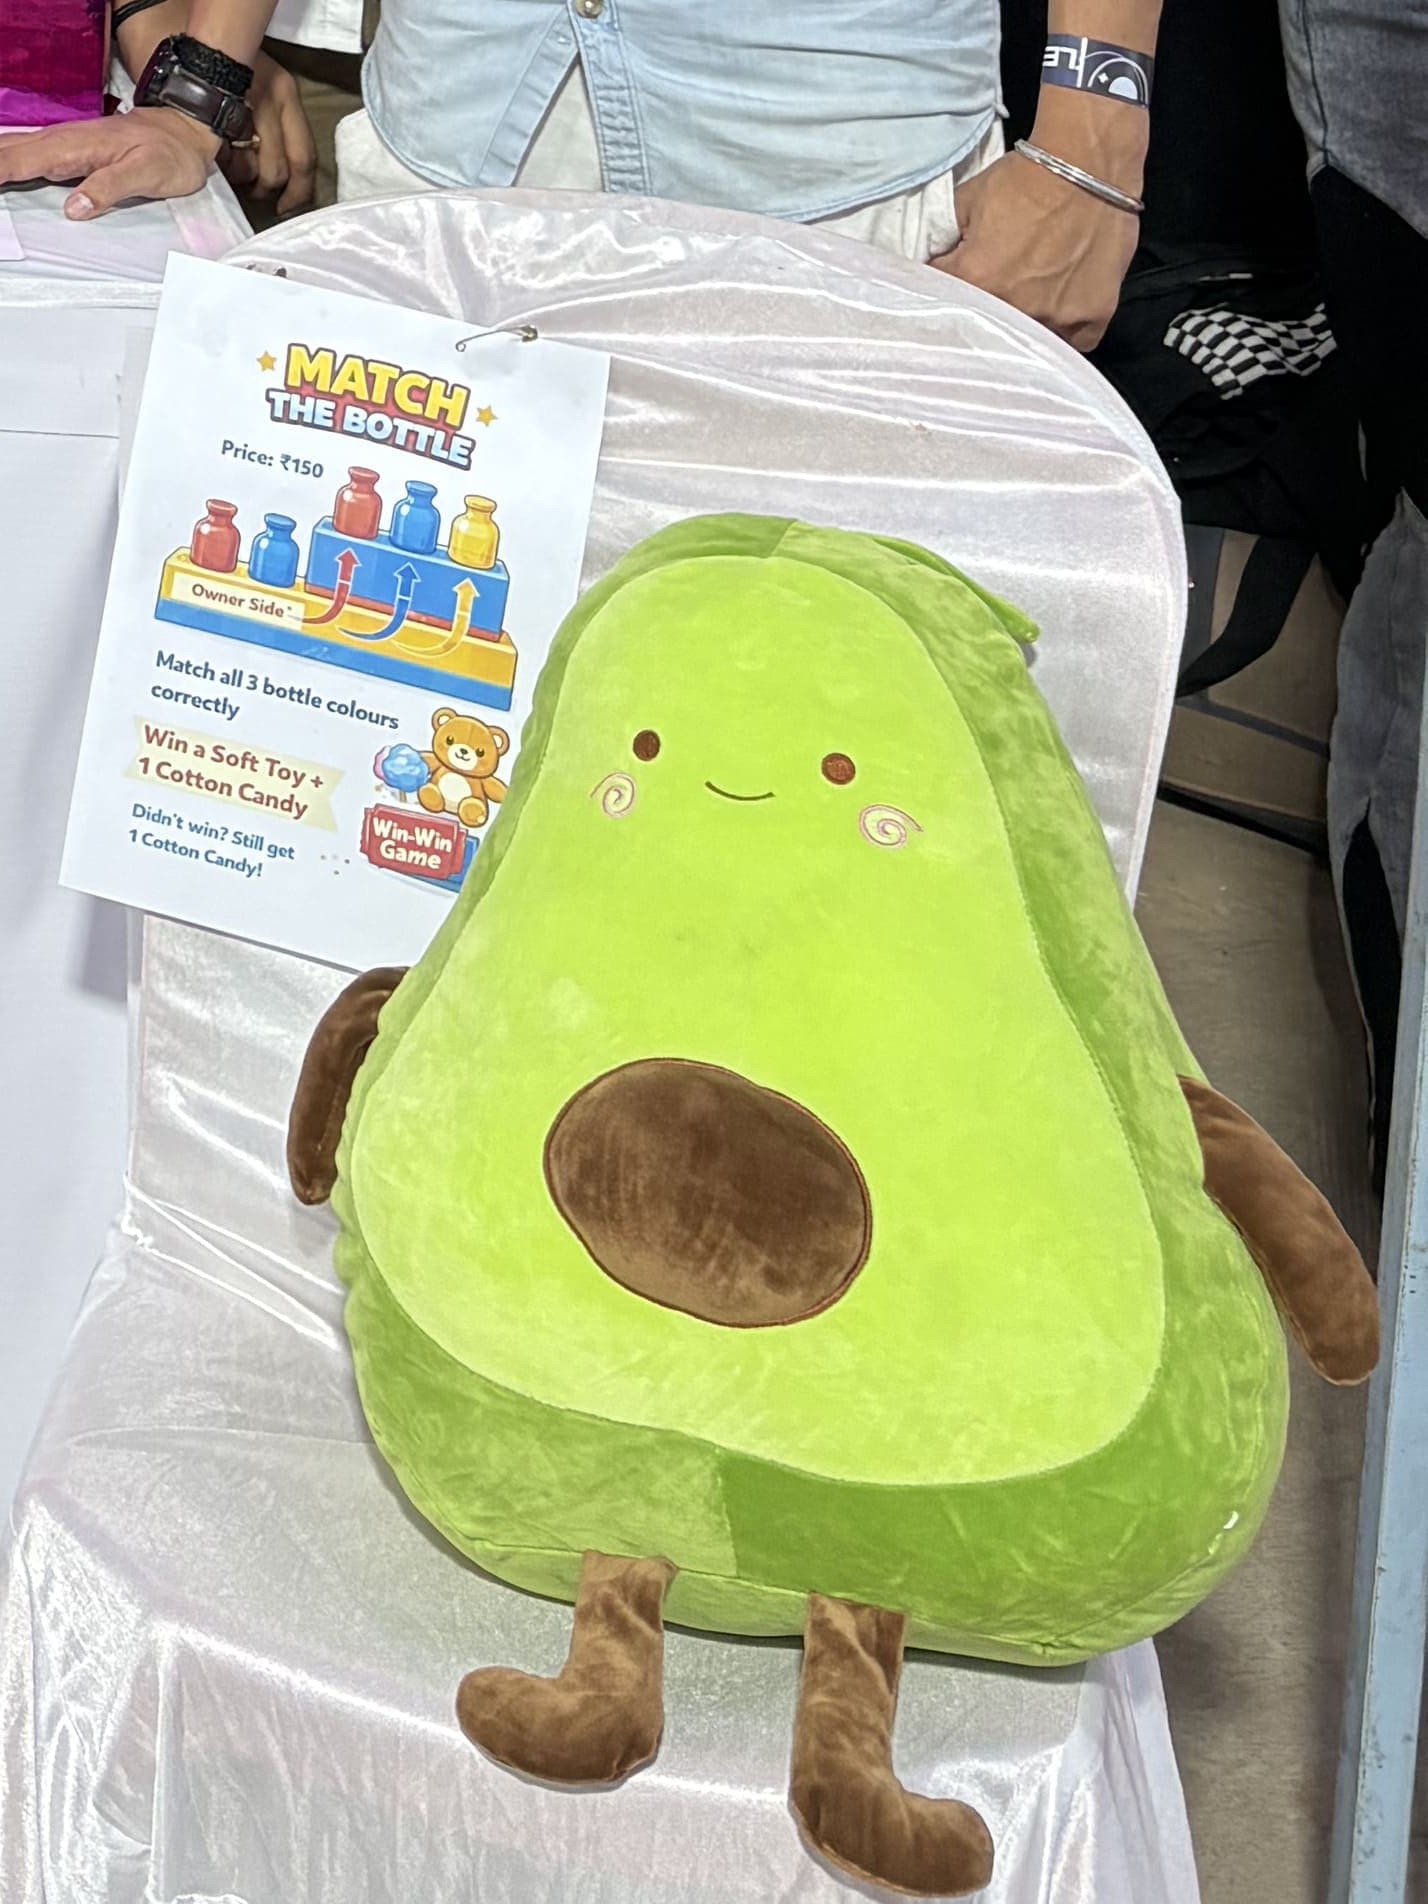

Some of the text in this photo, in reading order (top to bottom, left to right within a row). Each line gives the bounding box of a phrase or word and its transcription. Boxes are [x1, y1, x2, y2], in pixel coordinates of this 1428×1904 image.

[284, 343, 471, 430] MATCH
[266, 389, 476, 470] THE BOTTLE
[221, 440, 324, 478] Price: ₹150
[192, 583, 245, 607] Owner
[151, 685, 241, 721] correctly
[156, 650, 399, 729] Match all 3 bottle colours
[144, 724, 324, 789] Win a Soft Toy +
[139, 757, 308, 820] 1 Cotton Candy
[129, 829, 263, 878] 1 Cotton Candy!
[132, 803, 295, 860] Didn't win? Still get
[372, 817, 453, 853] Win-Win
[380, 840, 441, 869] Game
